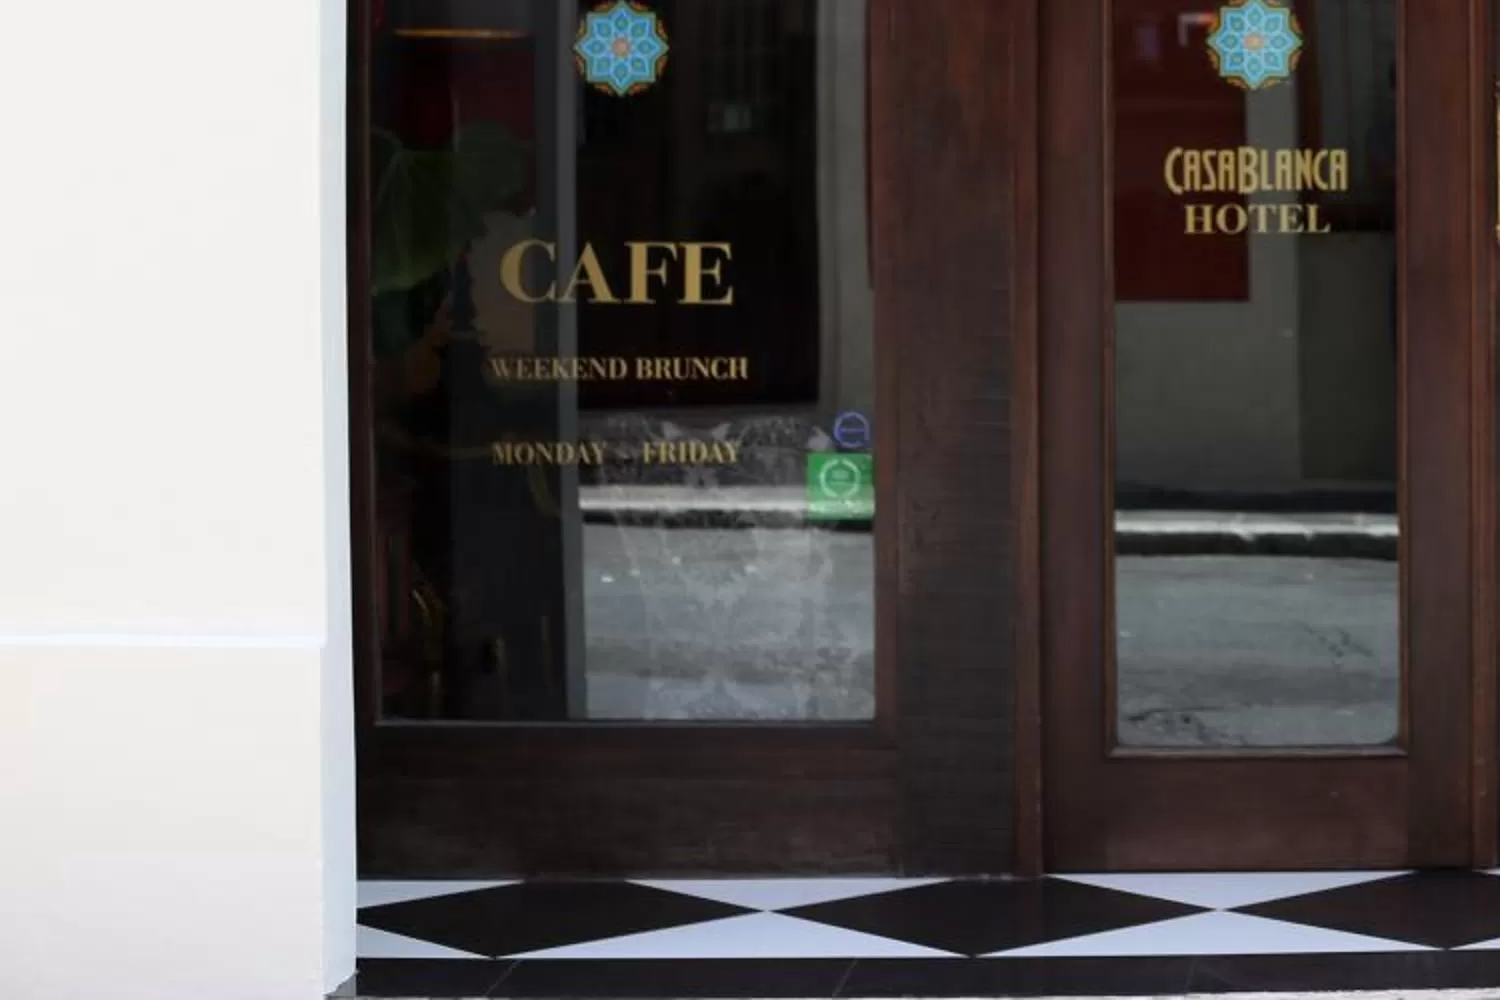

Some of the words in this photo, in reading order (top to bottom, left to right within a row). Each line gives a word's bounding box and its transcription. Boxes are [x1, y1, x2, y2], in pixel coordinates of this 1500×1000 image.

[1164, 147, 1348, 194] CASABLANCA
[1184, 204, 1330, 234] HOTEL
[500, 239, 733, 305] CAFE
[490, 357, 627, 381] WEEKEND
[636, 357, 749, 380] BRUNCH
[491, 442, 606, 465] MONDAY
[643, 441, 740, 464] FRIDAY
